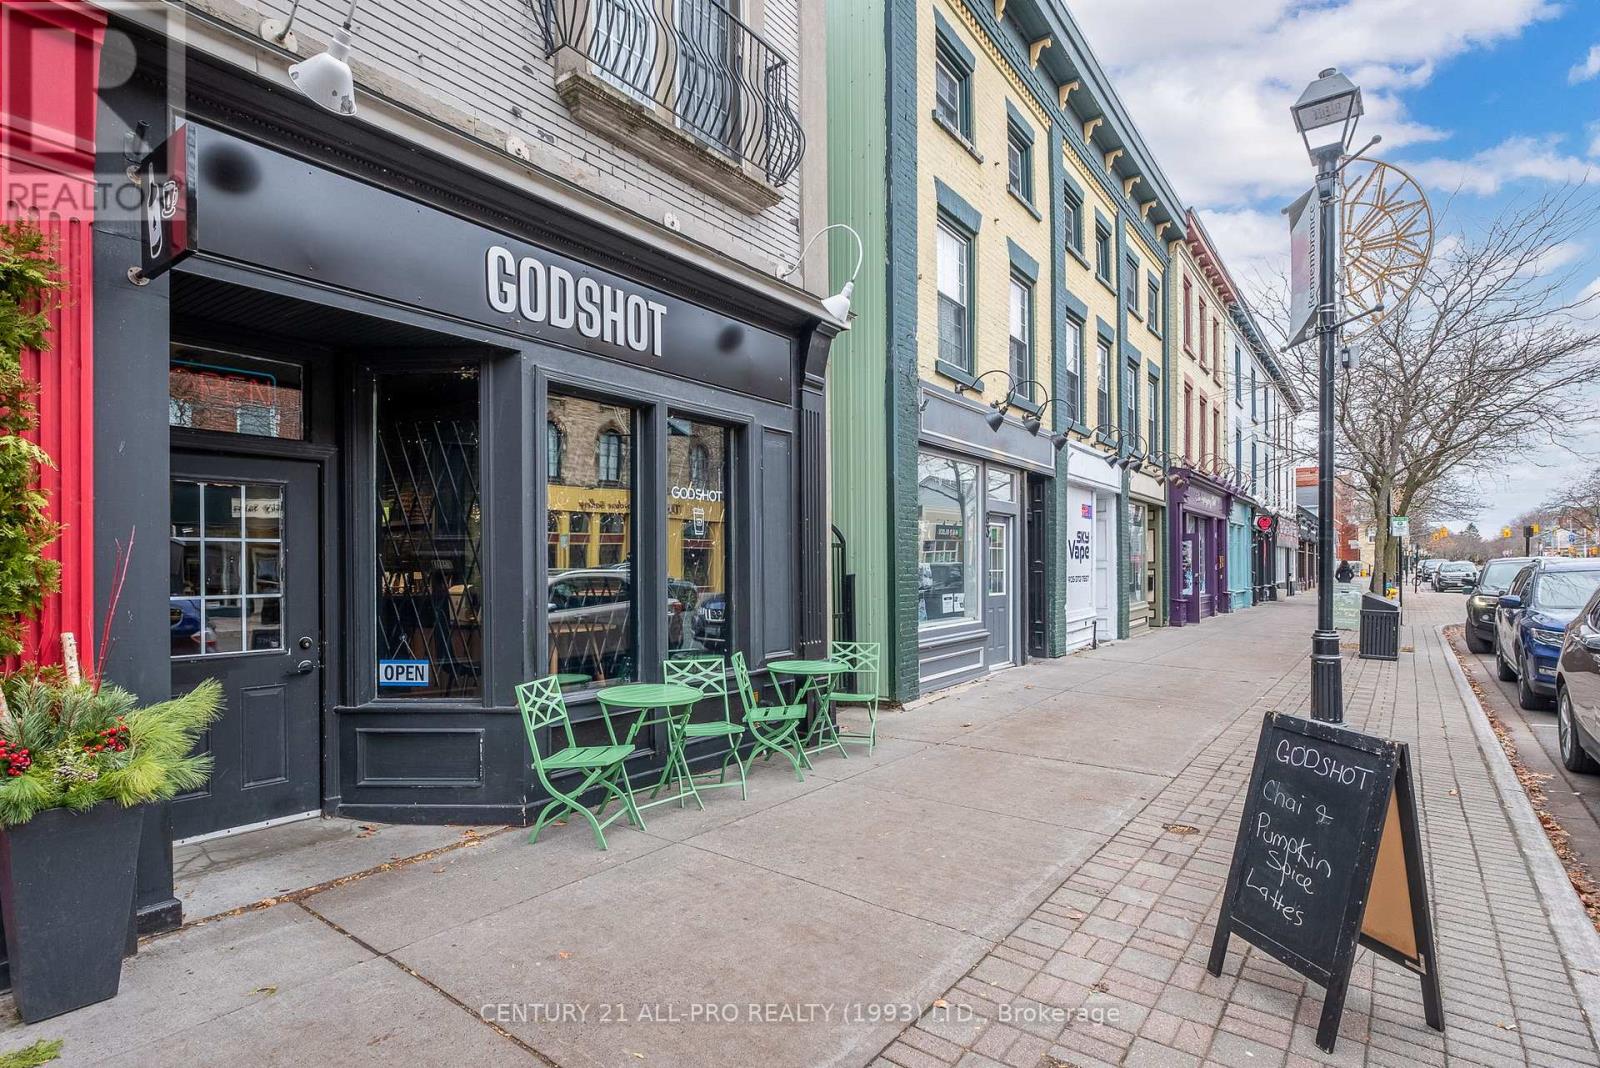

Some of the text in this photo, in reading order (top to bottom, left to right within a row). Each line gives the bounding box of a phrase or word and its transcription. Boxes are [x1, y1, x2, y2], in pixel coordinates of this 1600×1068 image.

[1308, 203, 1316, 309] Remembrance
[486, 245, 667, 357] GODSHOT
[671, 485, 723, 502] GODSHOT
[1068, 539, 1090, 564] Vape
[384, 664, 425, 682] OPEN
[1276, 739, 1374, 790] GODSHOT
[1263, 779, 1306, 815] Chai
[1256, 812, 1332, 878] Pumpkin
[1266, 849, 1314, 894] Spice
[1246, 867, 1305, 926] Lattes
